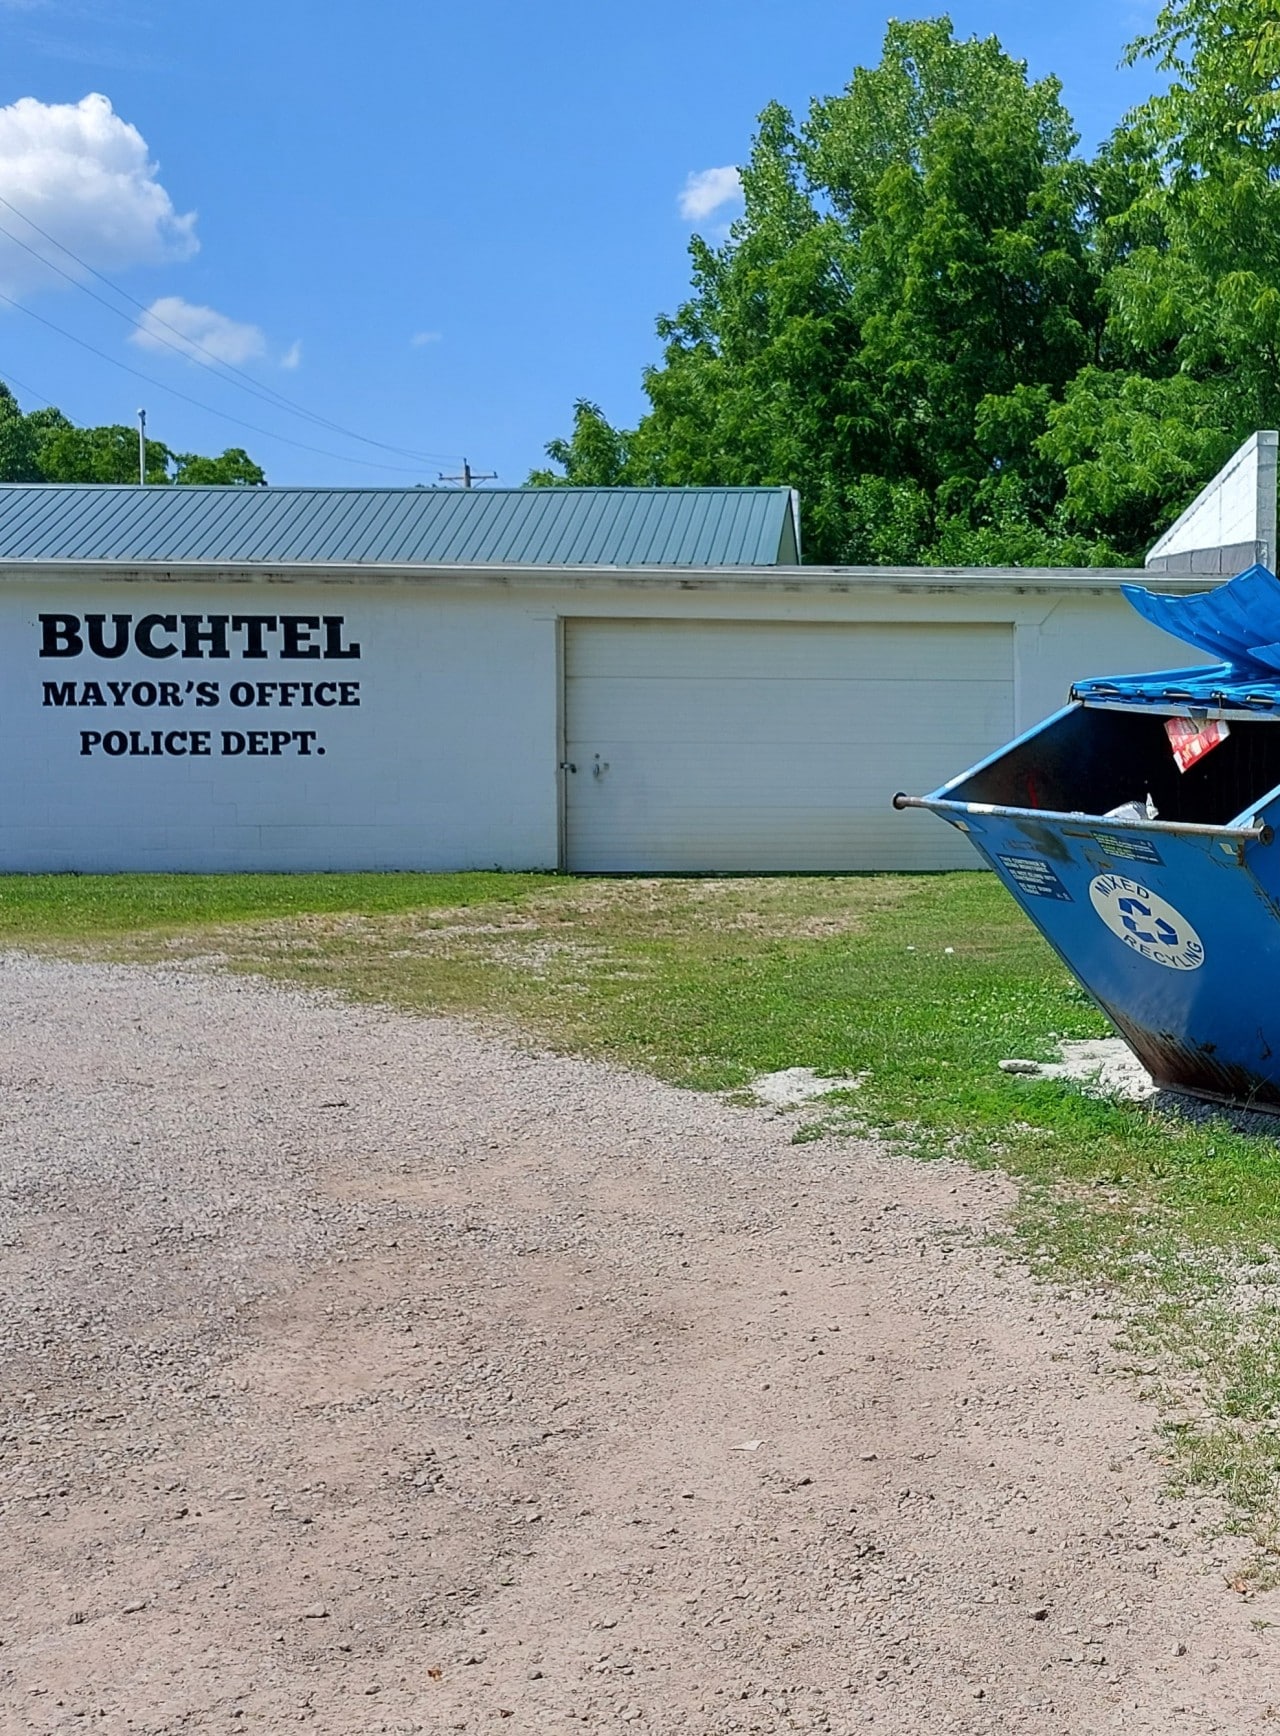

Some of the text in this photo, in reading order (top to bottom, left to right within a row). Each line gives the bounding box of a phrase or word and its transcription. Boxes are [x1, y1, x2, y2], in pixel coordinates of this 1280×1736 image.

[38, 613, 361, 659] BUCHTEL
[42, 680, 361, 707] MAYOR'S OFFICE
[80, 730, 327, 756] POLICE DEPT.
[1094, 876, 1150, 900] MIXED
[1124, 934, 1202, 969] RECYCLING
